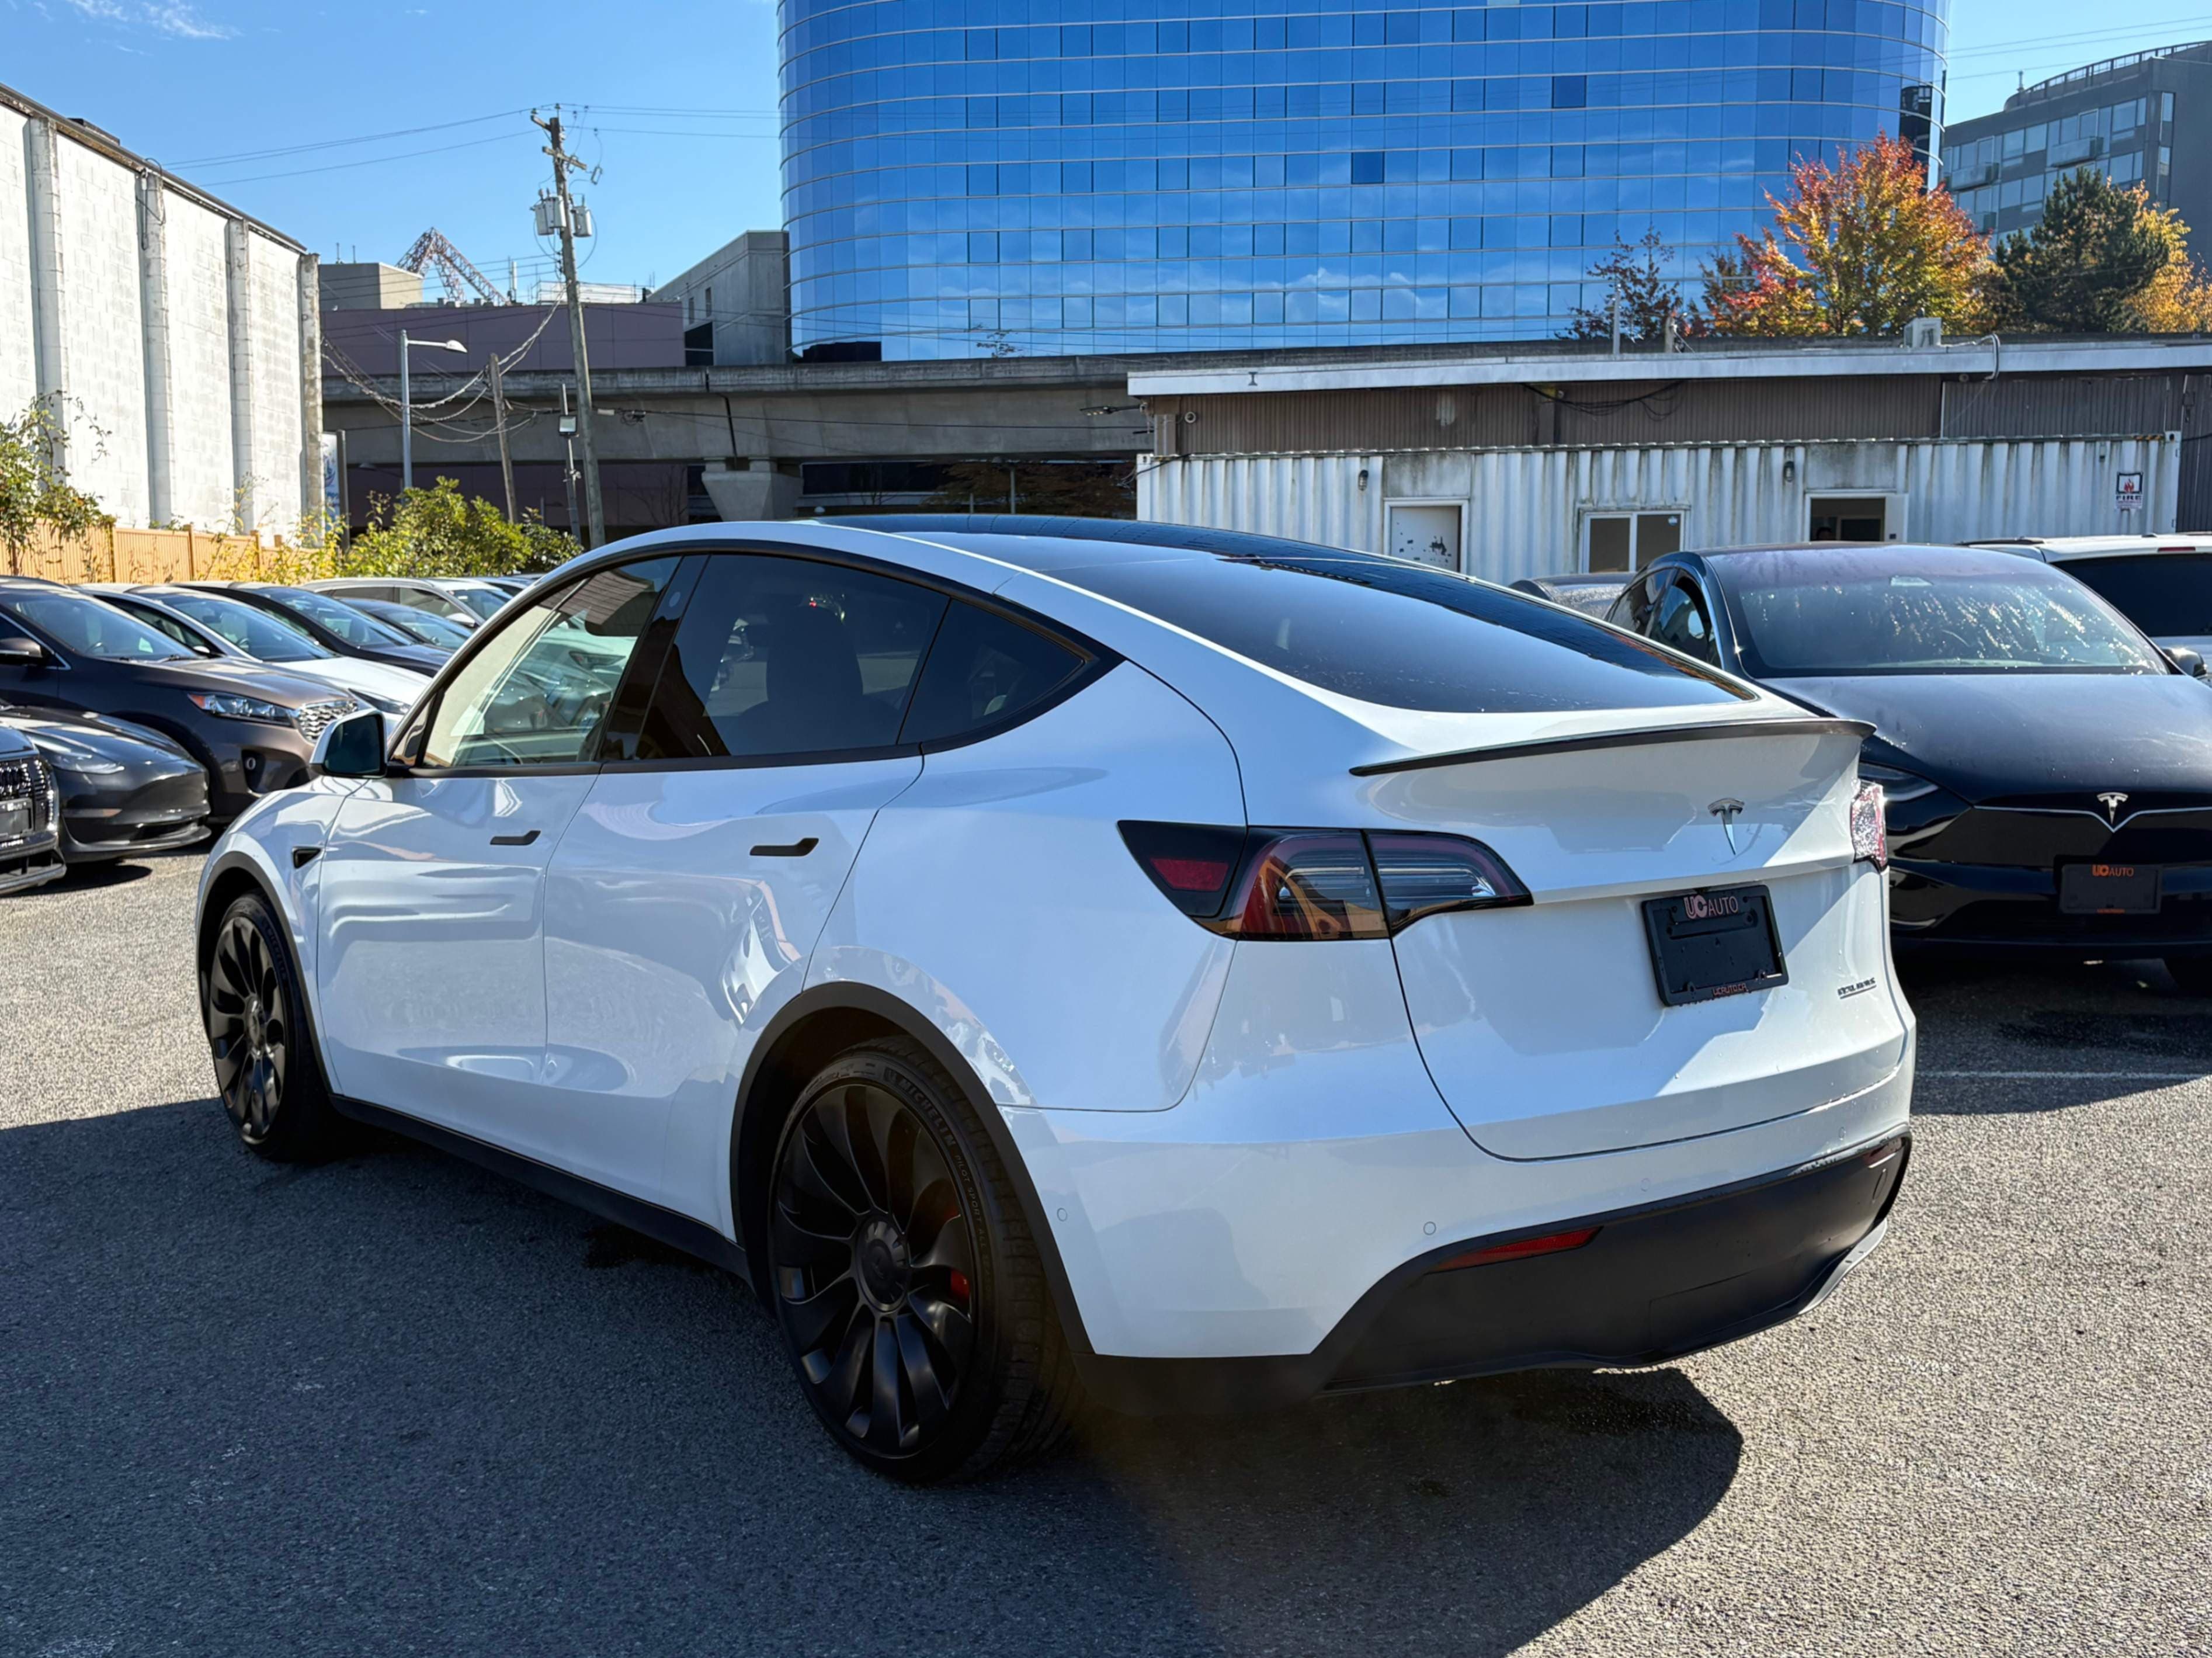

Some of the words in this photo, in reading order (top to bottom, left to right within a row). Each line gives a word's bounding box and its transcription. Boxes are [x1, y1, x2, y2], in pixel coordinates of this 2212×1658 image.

[898, 1078, 956, 1147] MICHELIN
[953, 1154, 970, 1182] PILOT
[967, 1187, 982, 1223] SPORT
